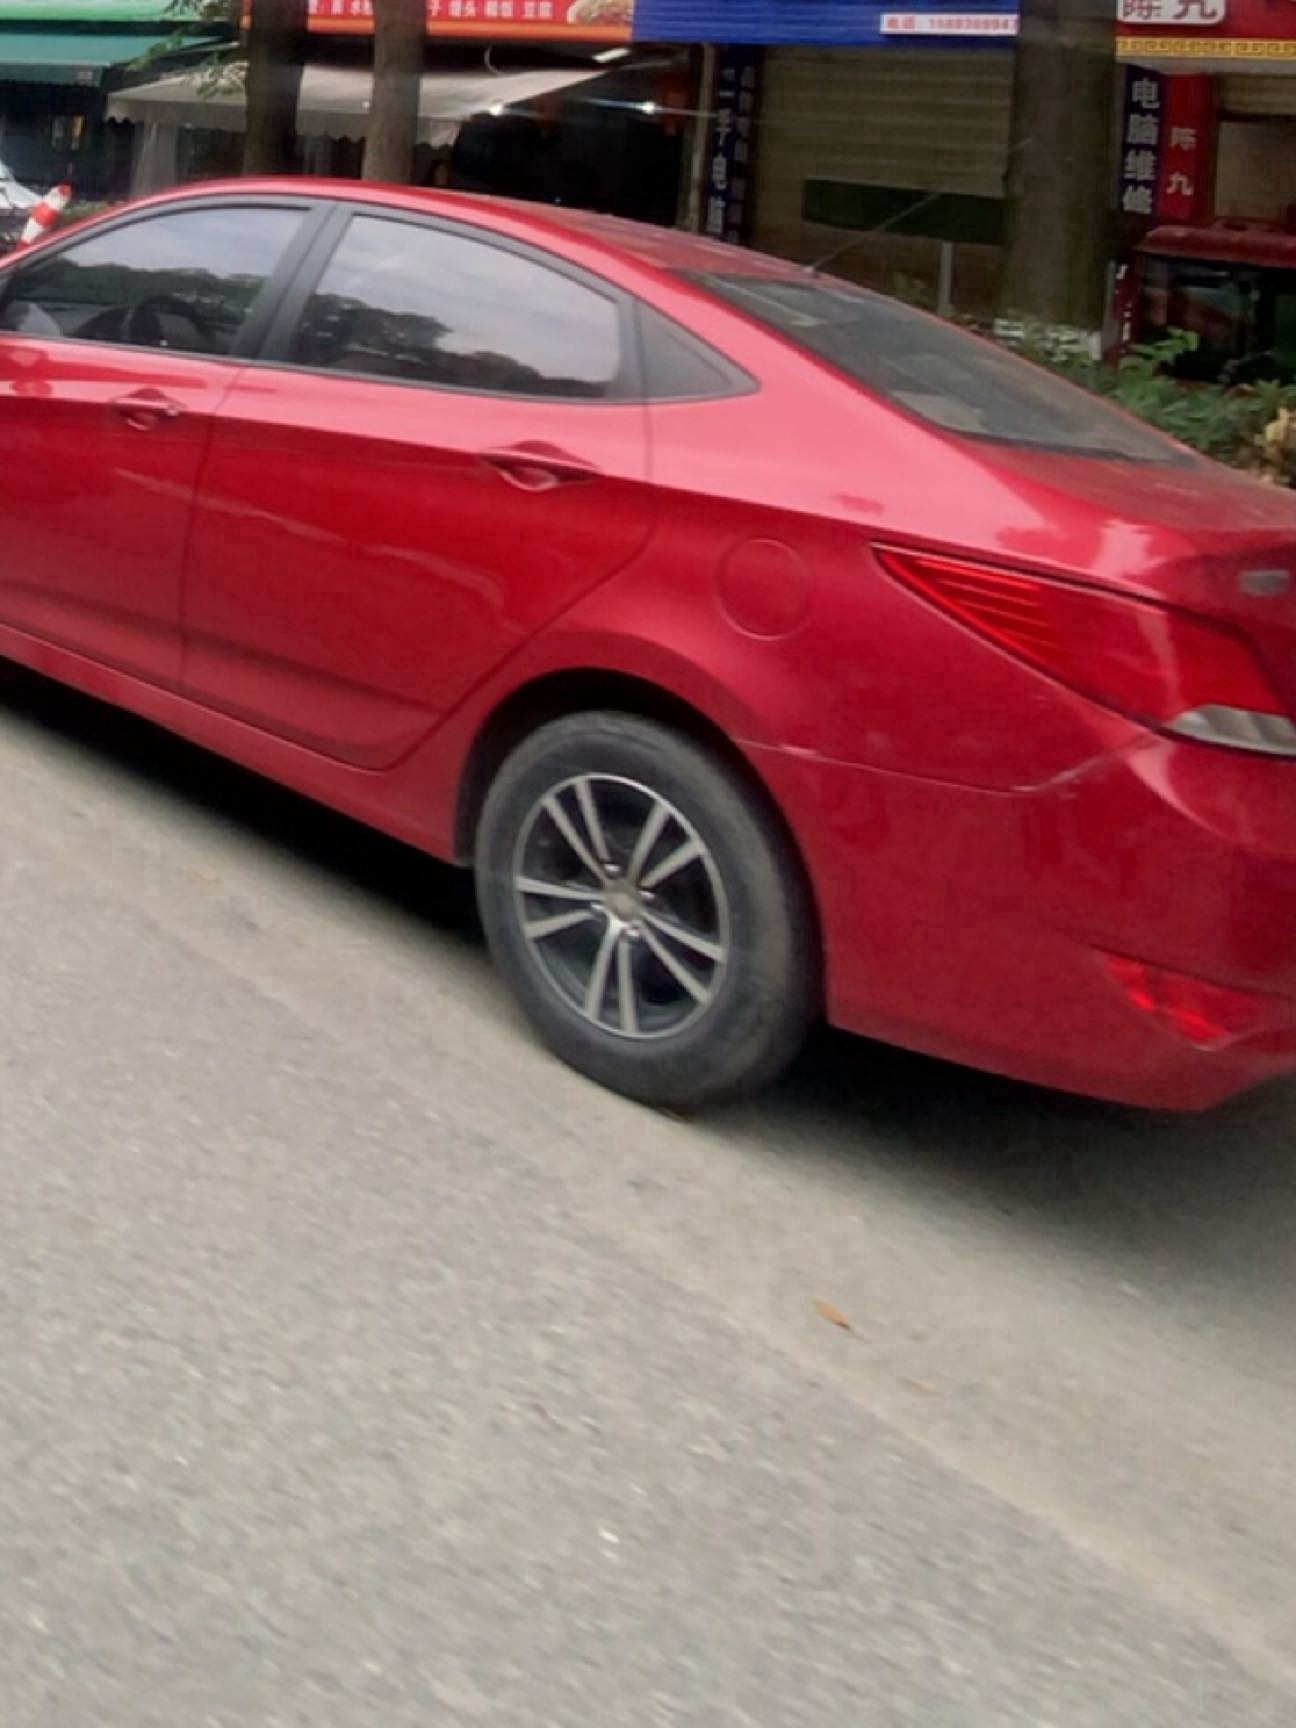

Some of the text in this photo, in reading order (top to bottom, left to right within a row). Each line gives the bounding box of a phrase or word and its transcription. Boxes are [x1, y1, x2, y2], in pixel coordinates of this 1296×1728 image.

[1123, 77, 1160, 214] 电脑维修
[1166, 127, 1197, 196] 陈九
